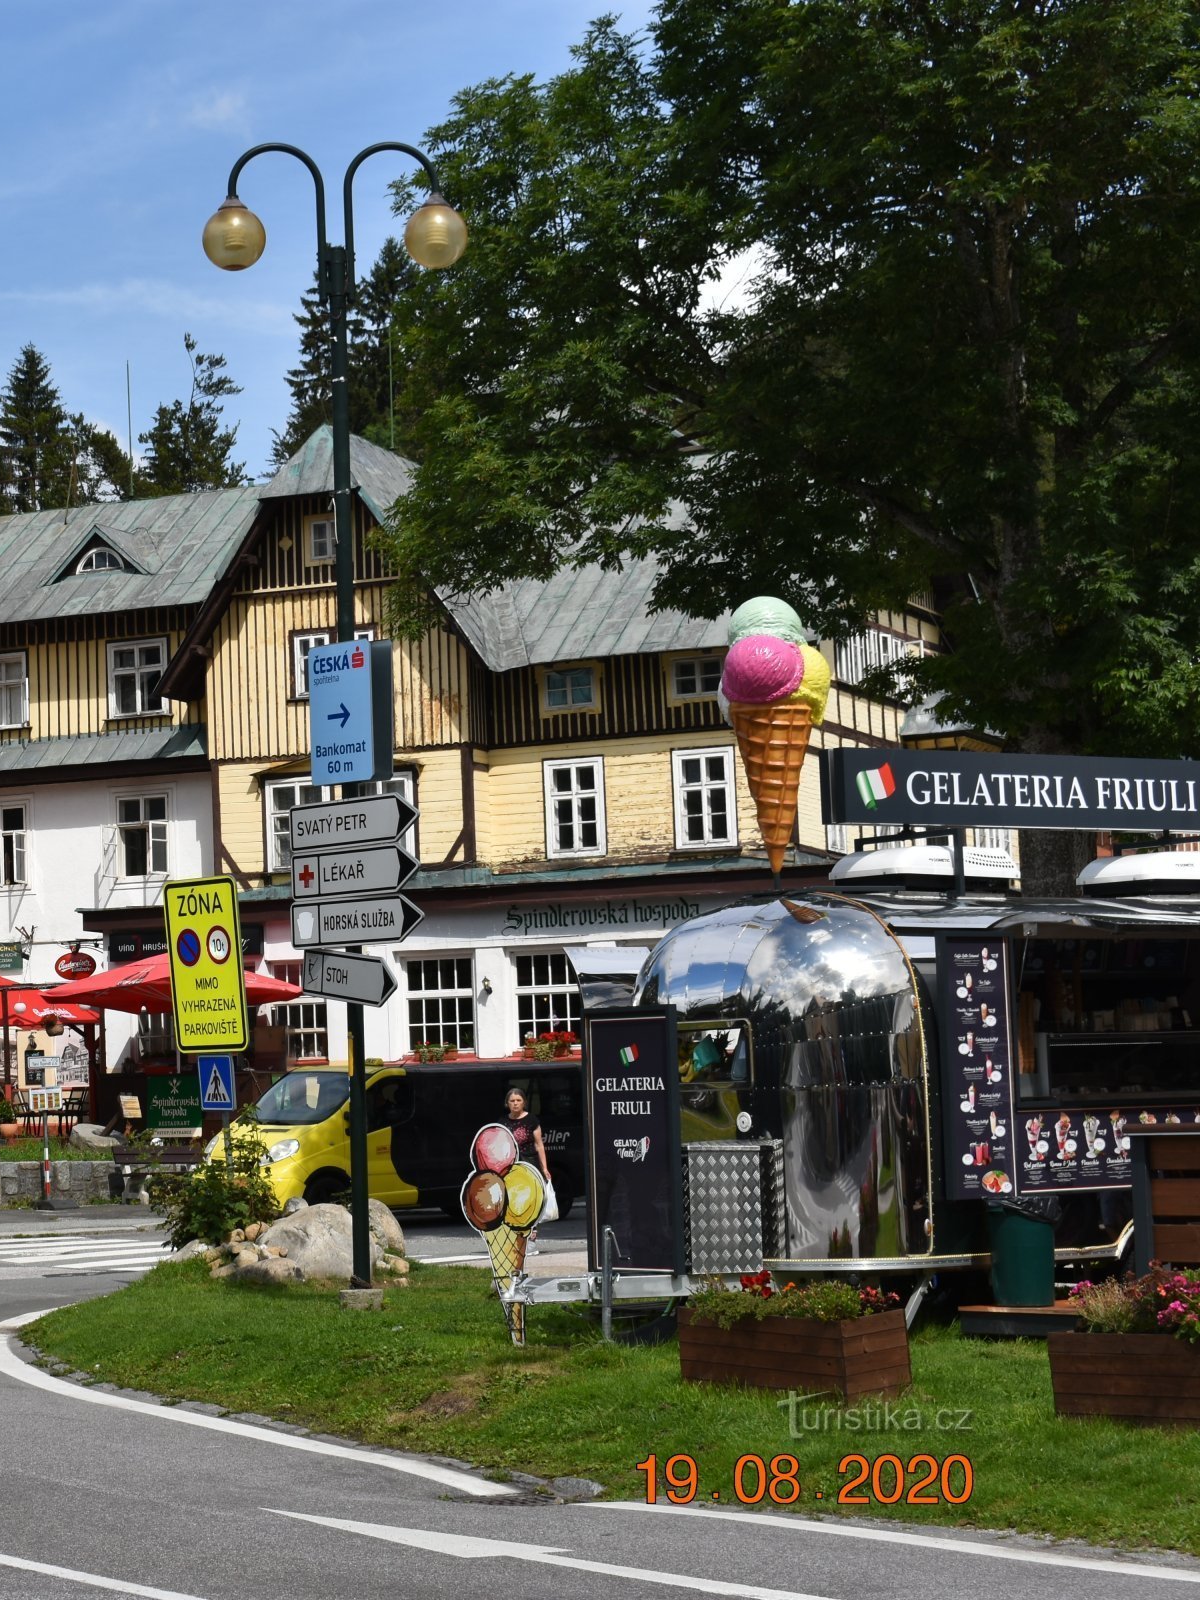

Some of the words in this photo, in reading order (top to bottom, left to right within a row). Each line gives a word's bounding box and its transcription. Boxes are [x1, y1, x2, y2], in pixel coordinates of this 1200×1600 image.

[313, 650, 350, 675] ČESKÁ
[313, 674, 340, 687] spořitelna
[315, 739, 367, 758] Bankomat
[327, 760, 341, 774] 60
[343, 761, 353, 772] m
[905, 770, 1089, 809] GELATERIA
[1095, 777, 1198, 812] FRIULI
[297, 813, 333, 837] SVATÝ
[336, 813, 367, 832] PETR
[322, 860, 365, 883] LÉKAŘ
[177, 888, 223, 917] ZÓNA
[323, 909, 359, 932] HORSKÁ
[361, 908, 395, 929] SLUŽBA
[633, 896, 700, 928] hospoda
[142, 942, 168, 951] HRUŠK
[195, 976, 219, 990] MIMO
[325, 966, 349, 985] STOH
[181, 995, 237, 1013] VYHRAZENÁ
[184, 1018, 238, 1036] PARKOVIŠTĚ
[595, 1077, 666, 1092] GELATERIA
[161, 1107, 187, 1119] hospoda
[611, 1101, 652, 1115] FRIULI
[613, 1139, 638, 1147] GELATO
